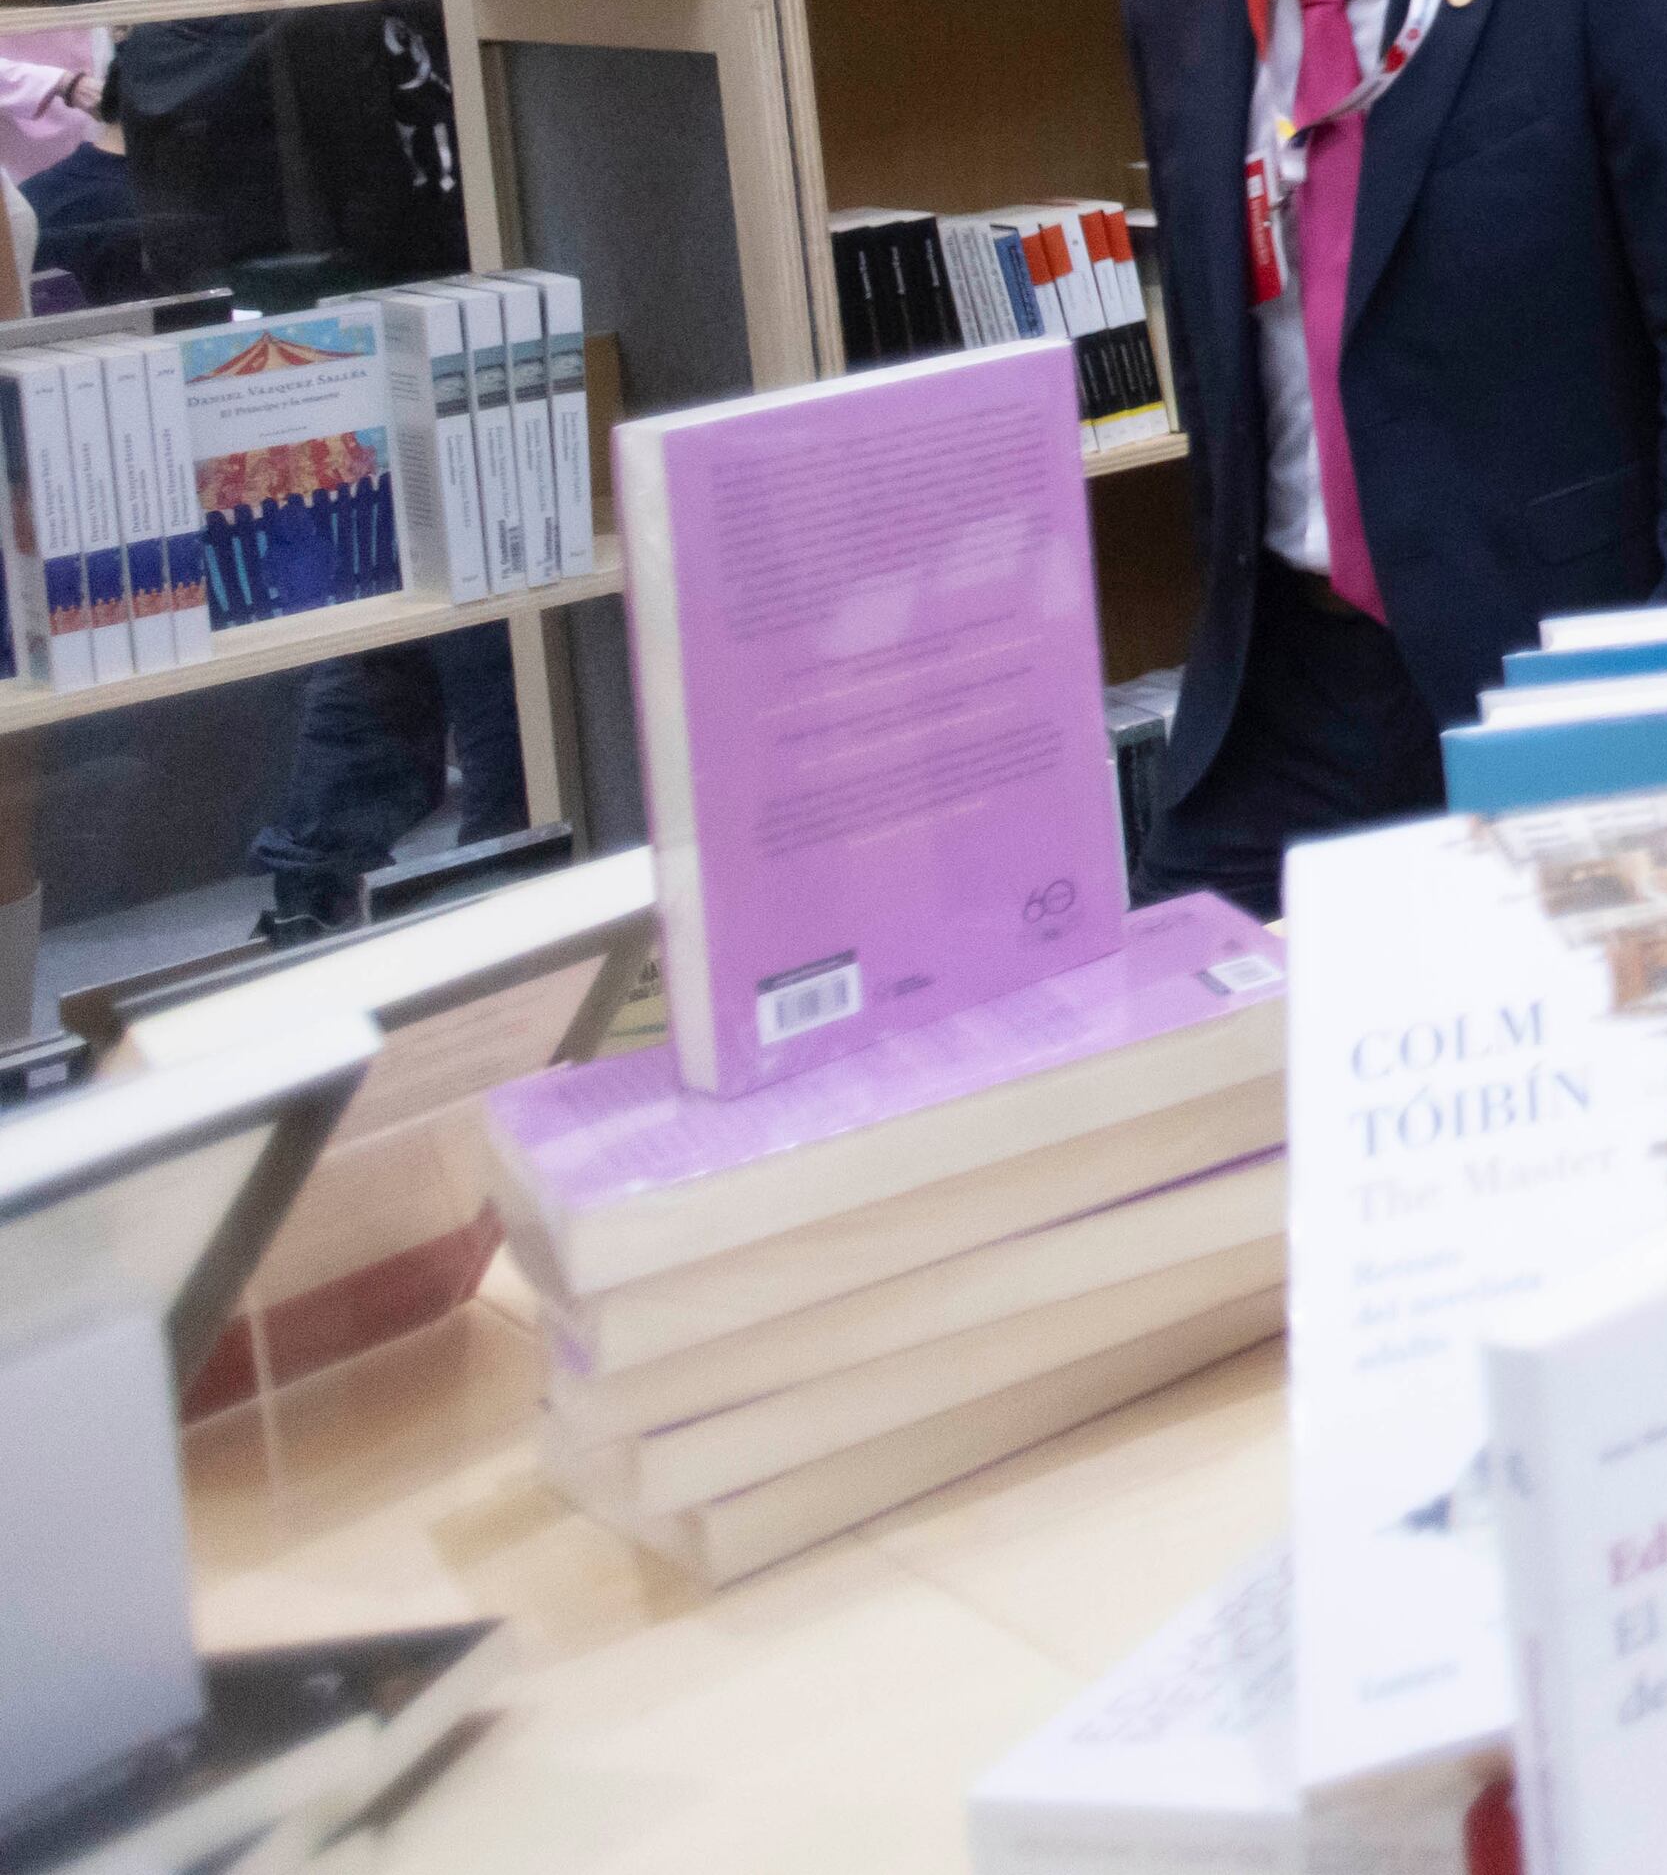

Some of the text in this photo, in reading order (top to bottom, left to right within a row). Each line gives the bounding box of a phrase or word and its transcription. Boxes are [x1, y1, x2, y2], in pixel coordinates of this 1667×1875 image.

[1350, 998, 1549, 1082] COLM
[1350, 1062, 1594, 1160] TÓIBÍN
[1613, 1603, 1664, 1658] El
